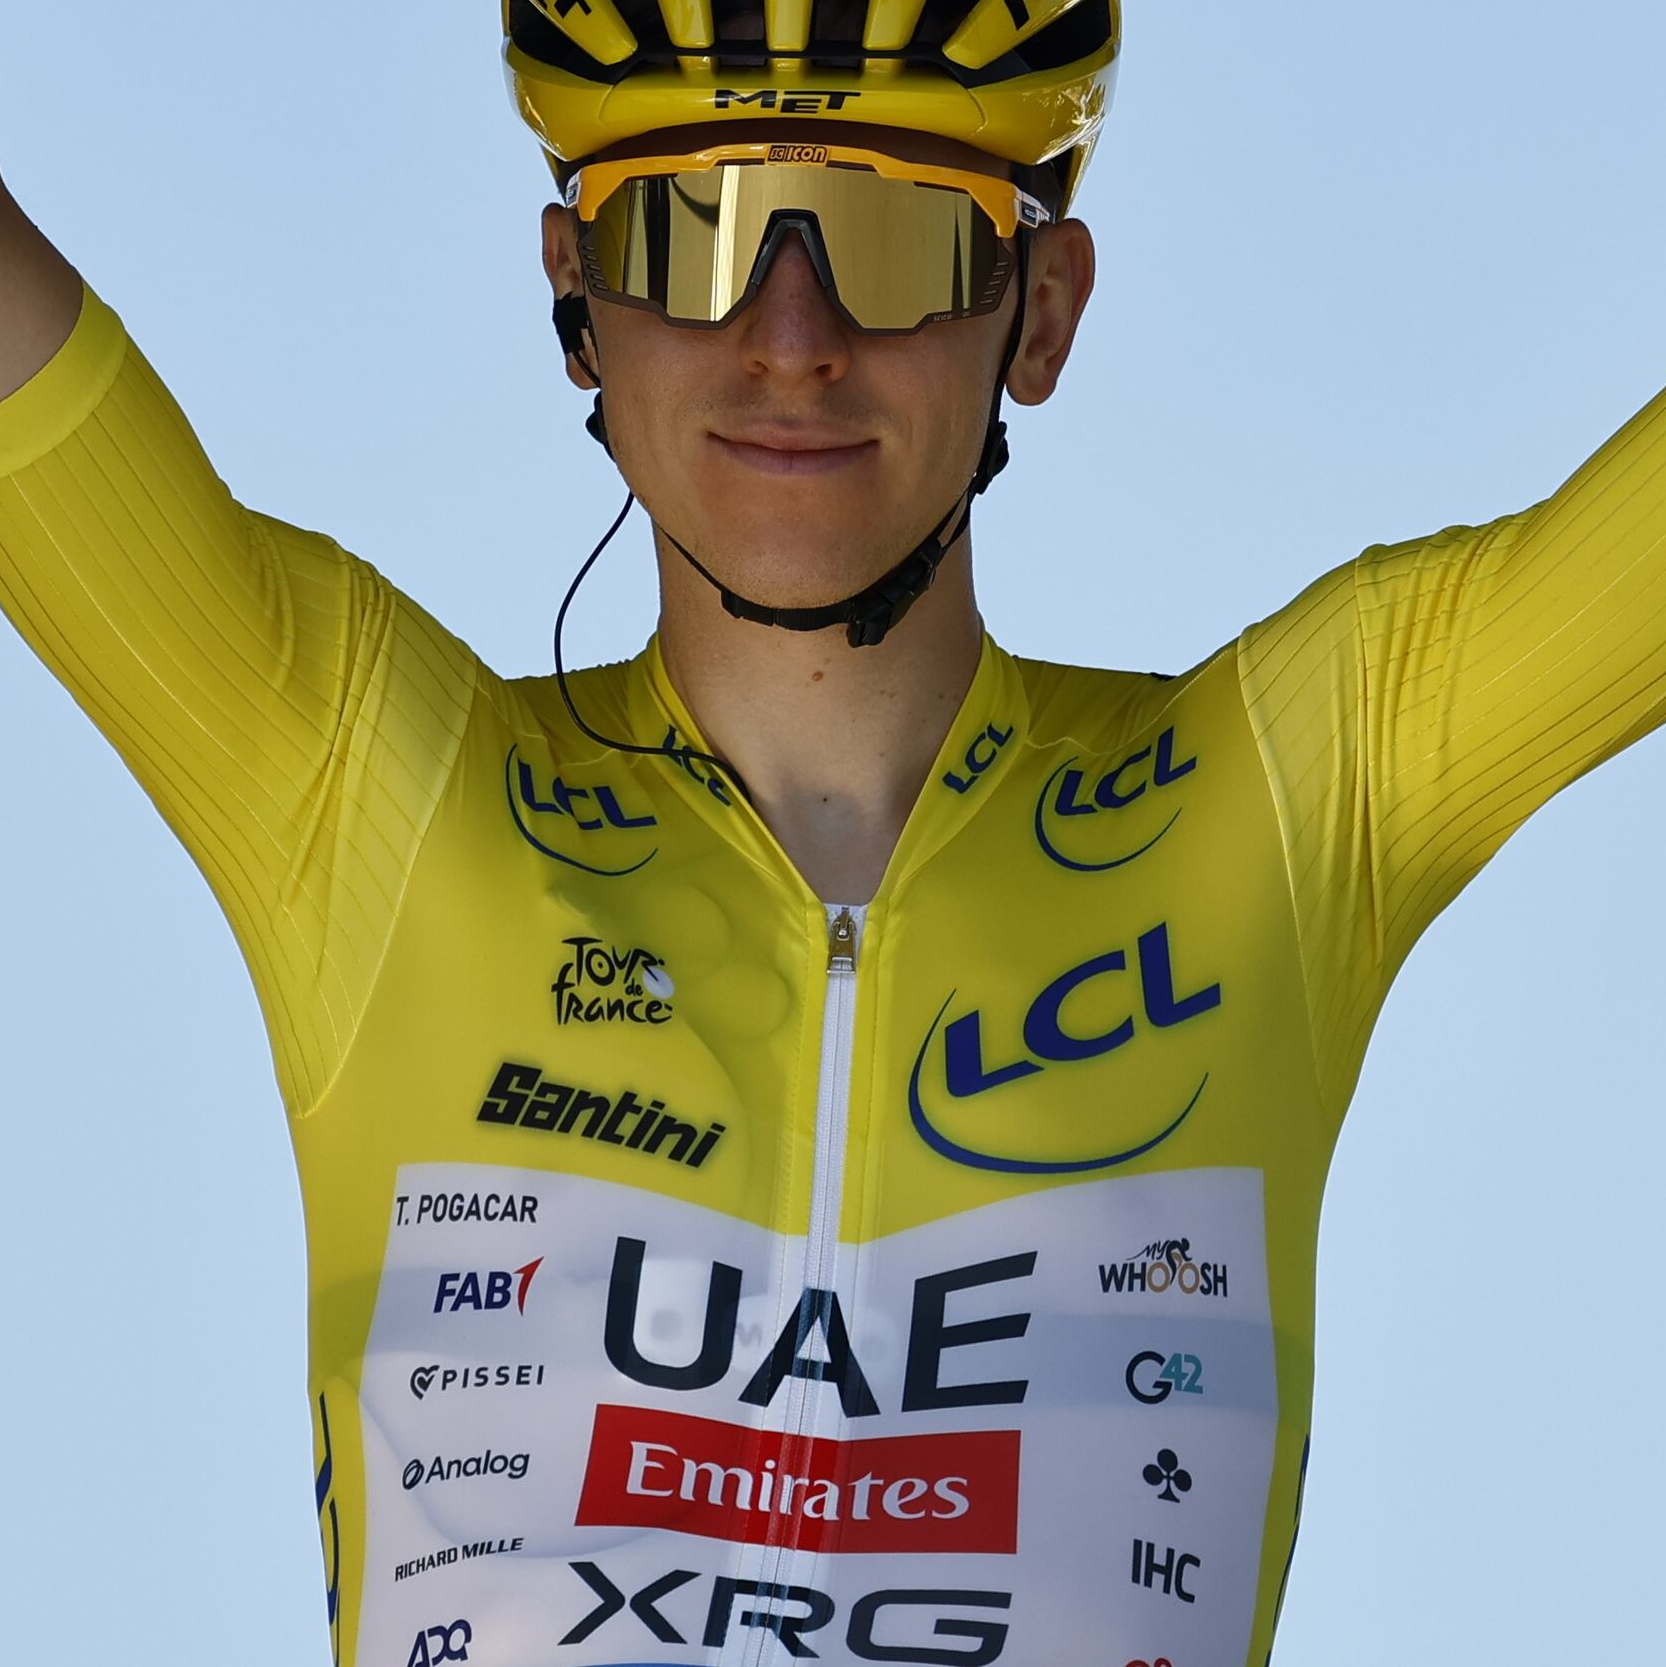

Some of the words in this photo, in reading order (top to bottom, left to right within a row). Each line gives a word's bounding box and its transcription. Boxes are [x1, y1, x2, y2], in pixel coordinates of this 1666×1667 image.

[715, 89, 861, 114] MET
[942, 722, 1014, 794] LCL
[1054, 725, 1197, 816] LCL
[517, 758, 657, 830] LCL
[625, 977, 643, 996] de
[944, 922, 1221, 1098] LCL
[476, 1062, 726, 1169] Santini
[396, 1196, 409, 1226] T.
[416, 1193, 539, 1224] POGACAR
[1098, 1261, 1228, 1297] WHOOSH
[603, 1236, 1038, 1418] UAE
[441, 1364, 545, 1391] PISSEI
[1125, 1350, 1204, 1405] G42
[425, 1449, 530, 1484] Analog
[626, 1440, 970, 1521] Emirates
[394, 1547, 458, 1582] RICHARD
[462, 1537, 524, 1560] MILLE
[1132, 1539, 1201, 1604] IHC
[407, 1619, 472, 1667] ADQ
[557, 1561, 1013, 1667] XRG
